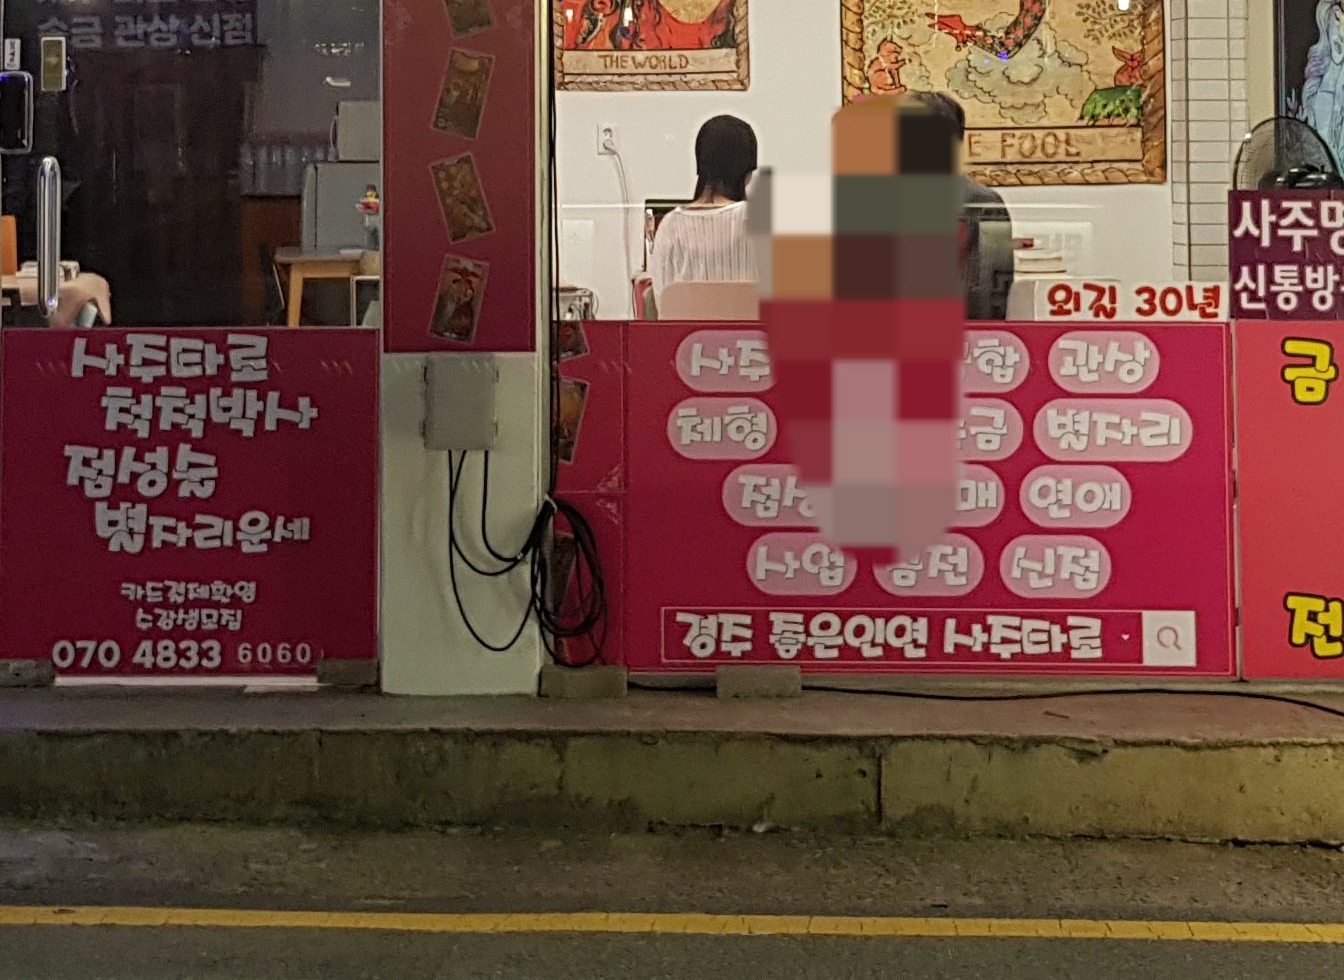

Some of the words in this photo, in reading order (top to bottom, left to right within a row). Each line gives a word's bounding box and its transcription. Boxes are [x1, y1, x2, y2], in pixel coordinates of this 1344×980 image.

[114, 14, 181, 48] 관상
[190, 13, 252, 46] 신점
[597, 54, 629, 69] THE
[631, 54, 689, 70] WORLD
[1001, 131, 1081, 159] FOOL
[1046, 281, 1119, 319] 외길
[1135, 284, 1221, 319] 30년
[70, 333, 270, 382] 사주타로
[964, 338, 1021, 384] 합
[1056, 339, 1151, 384] 관상
[101, 387, 318, 438] 척척박사
[676, 404, 769, 450] 체형
[1047, 407, 1181, 451] 별자리
[64, 444, 219, 498] 점성술
[957, 479, 998, 511] 매
[1027, 476, 1122, 520] 연애
[94, 501, 311, 553] 별자리운세
[755, 543, 845, 587] 사업
[1012, 546, 1101, 591] 신점
[120, 581, 256, 604] 카드결제환영
[136, 607, 243, 630] 수강생모집
[676, 612, 753, 658] 경주
[769, 612, 929, 658] 좋은인연
[944, 613, 1103, 658] 사주타로
[53, 639, 121, 668] 070
[132, 639, 222, 668] 4833
[238, 641, 313, 664] 6060
